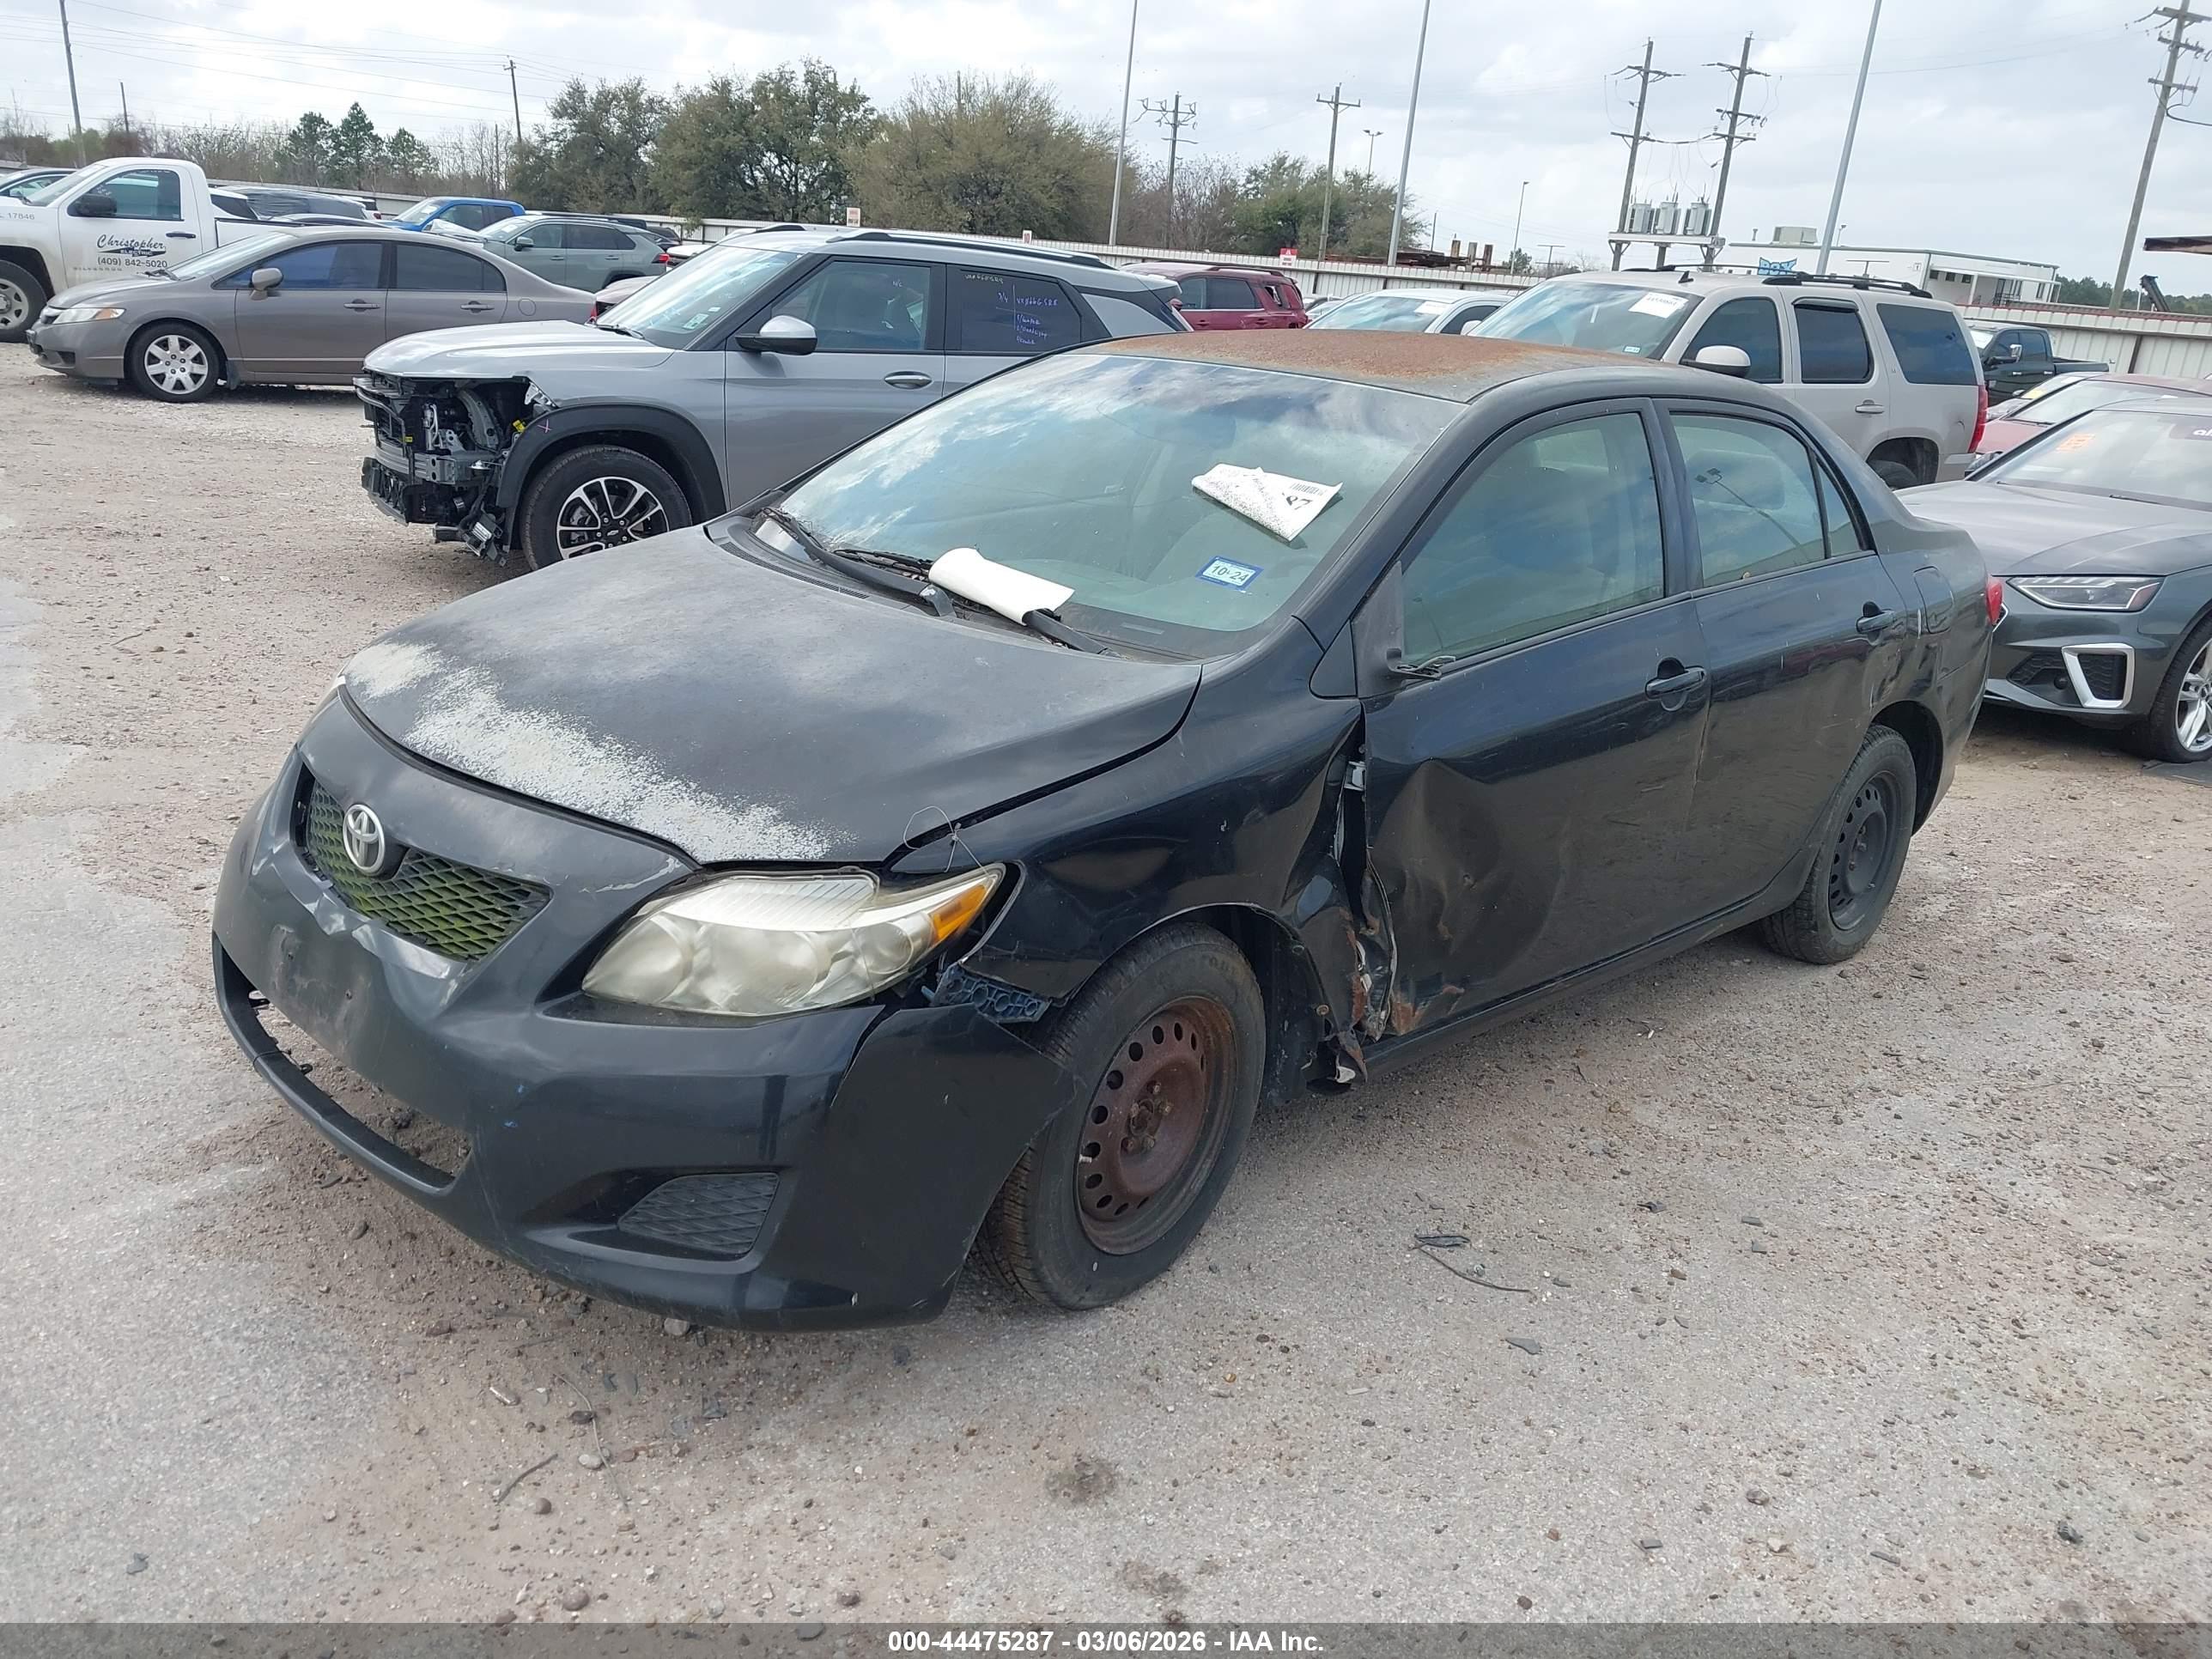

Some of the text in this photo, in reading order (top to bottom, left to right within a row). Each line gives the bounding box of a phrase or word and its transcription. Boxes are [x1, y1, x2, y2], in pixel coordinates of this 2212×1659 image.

[97, 234, 166, 250] Christopher
[98, 257, 167, 268] (409) 842-5020
